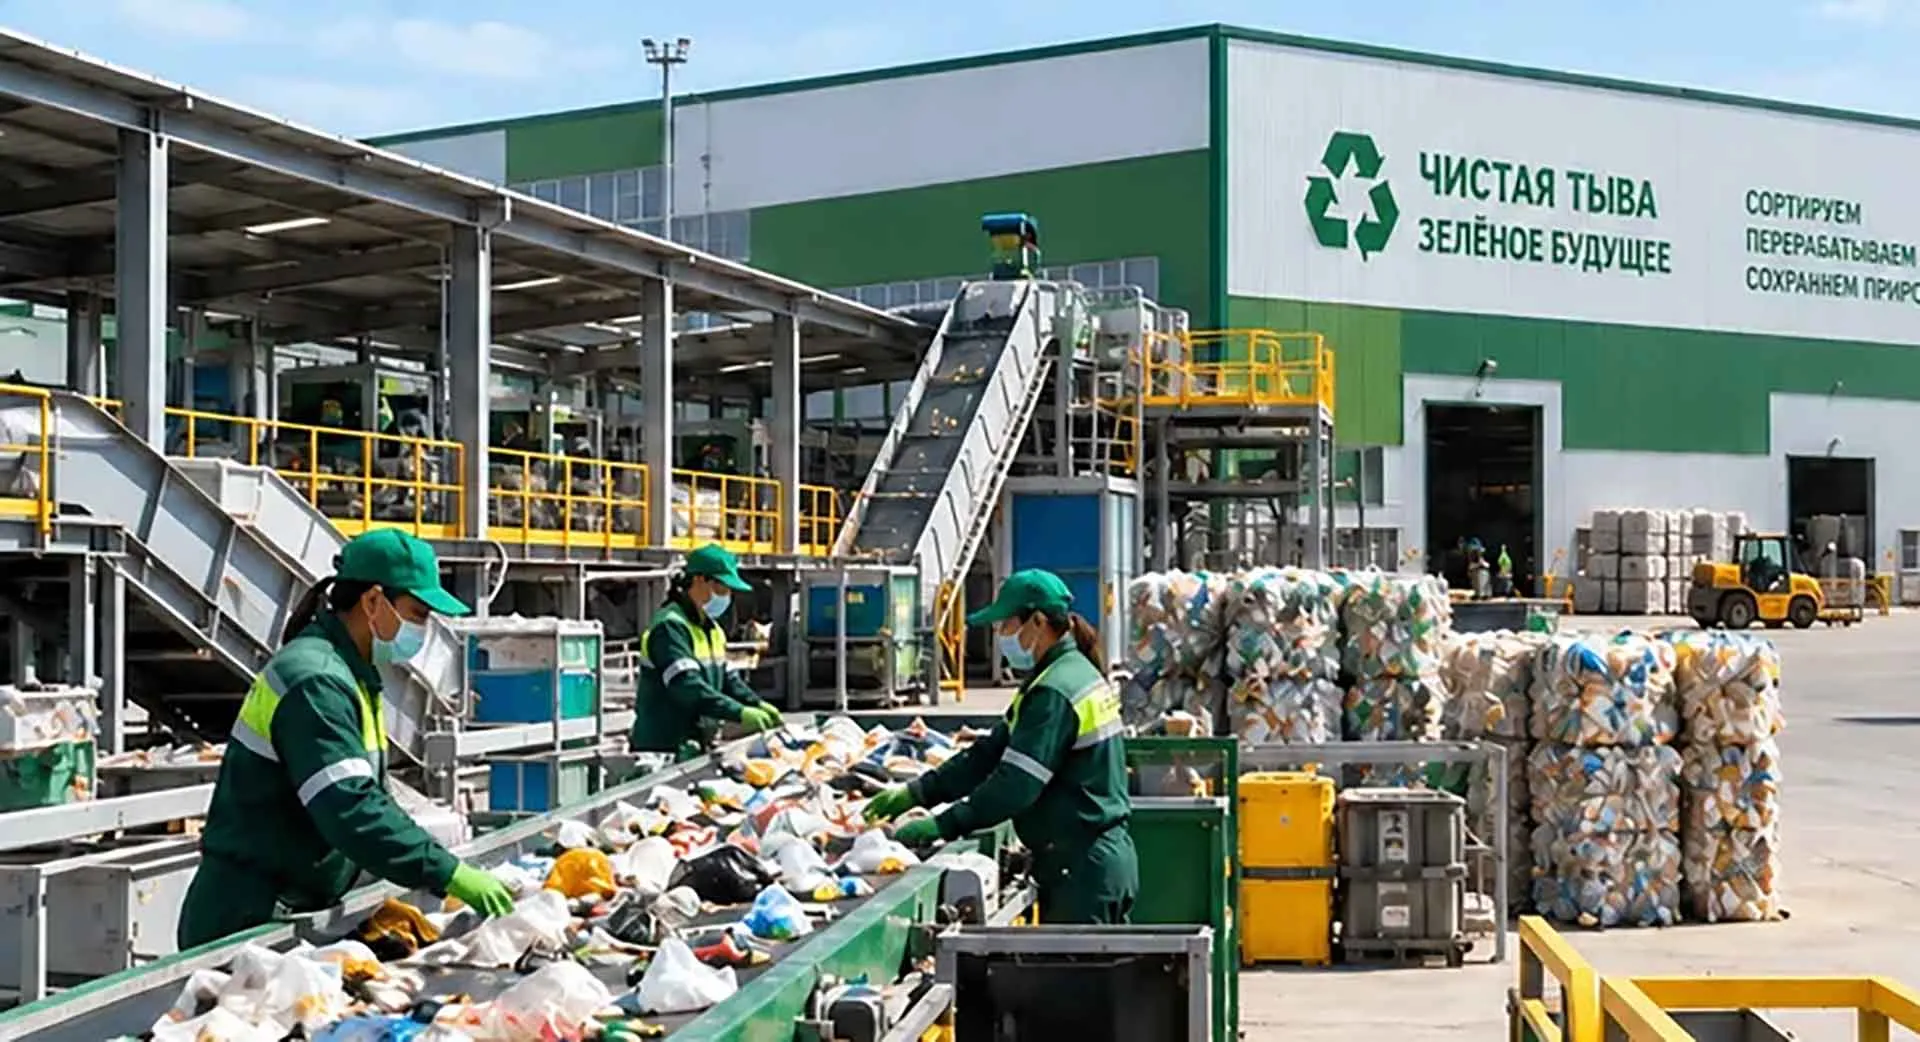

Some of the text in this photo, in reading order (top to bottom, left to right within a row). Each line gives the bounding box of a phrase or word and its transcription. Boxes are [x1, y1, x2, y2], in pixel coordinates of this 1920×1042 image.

[1419, 151, 1658, 219] ЧИСТАЯ ТЫВА
[1746, 189, 1862, 225] СОРТИРУЕМ
[1418, 215, 1672, 276] ЗЕЛЁНОЕ БУДУЩЕЕ
[1746, 228, 1917, 267] ПЕРЕРАБАТЫВАЕМ
